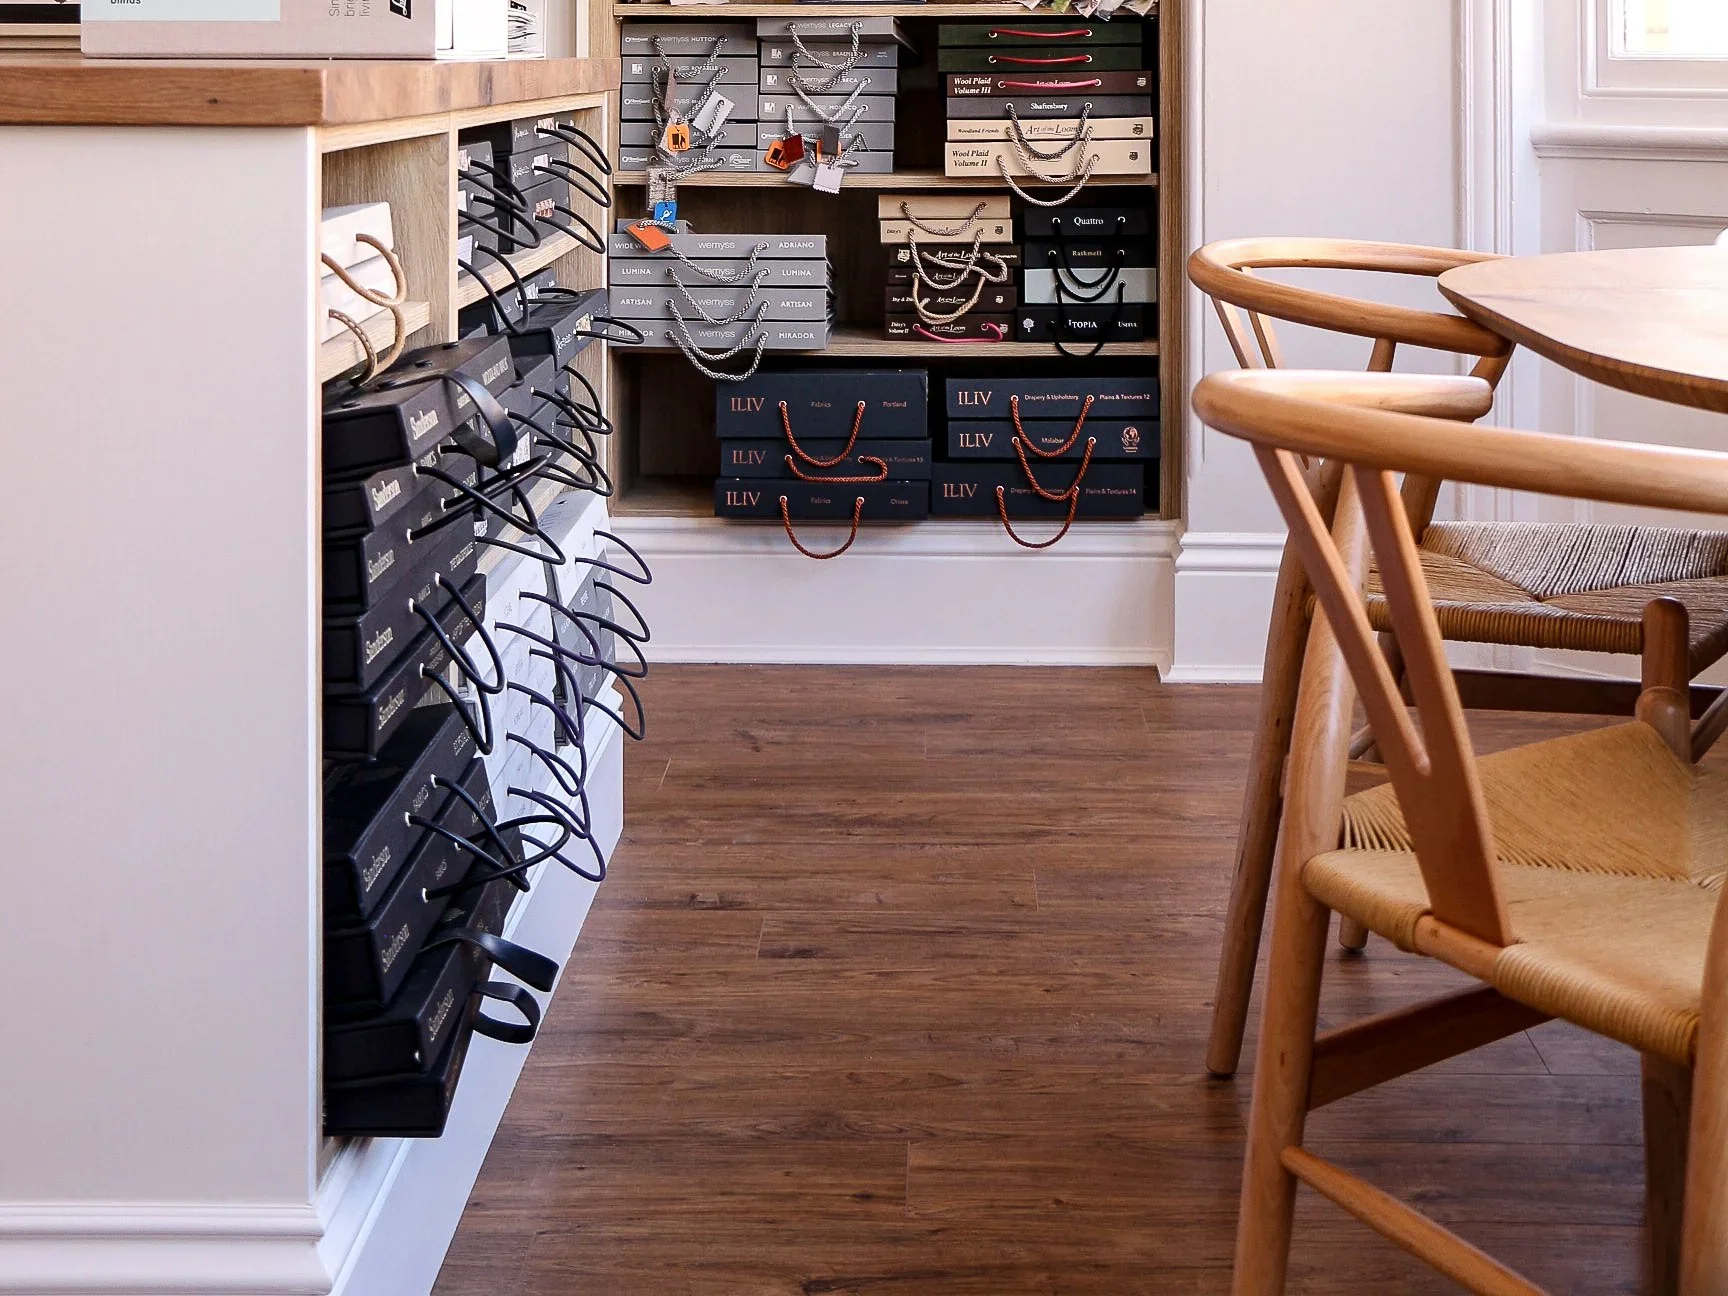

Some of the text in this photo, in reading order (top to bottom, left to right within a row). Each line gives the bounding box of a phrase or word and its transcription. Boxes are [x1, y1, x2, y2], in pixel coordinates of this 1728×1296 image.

[954, 77, 992, 85] Wool Plaid
[981, 86, 992, 94] III
[1025, 125, 1040, 135] Art
[952, 149, 990, 157] Wool Plaid
[953, 159, 988, 167] Volume II
[1073, 216, 1104, 227] Quattro
[698, 242, 736, 252] wemyss
[698, 298, 735, 307] wemyss
[698, 330, 736, 339] wemyss
[958, 391, 993, 406] ILIV
[730, 397, 766, 412] ILIV
[959, 433, 993, 448] ILIV
[732, 450, 767, 465] ILIV
[943, 483, 978, 498] ILIV
[726, 491, 761, 506] ILIV
[810, 497, 831, 505] Fabrics
